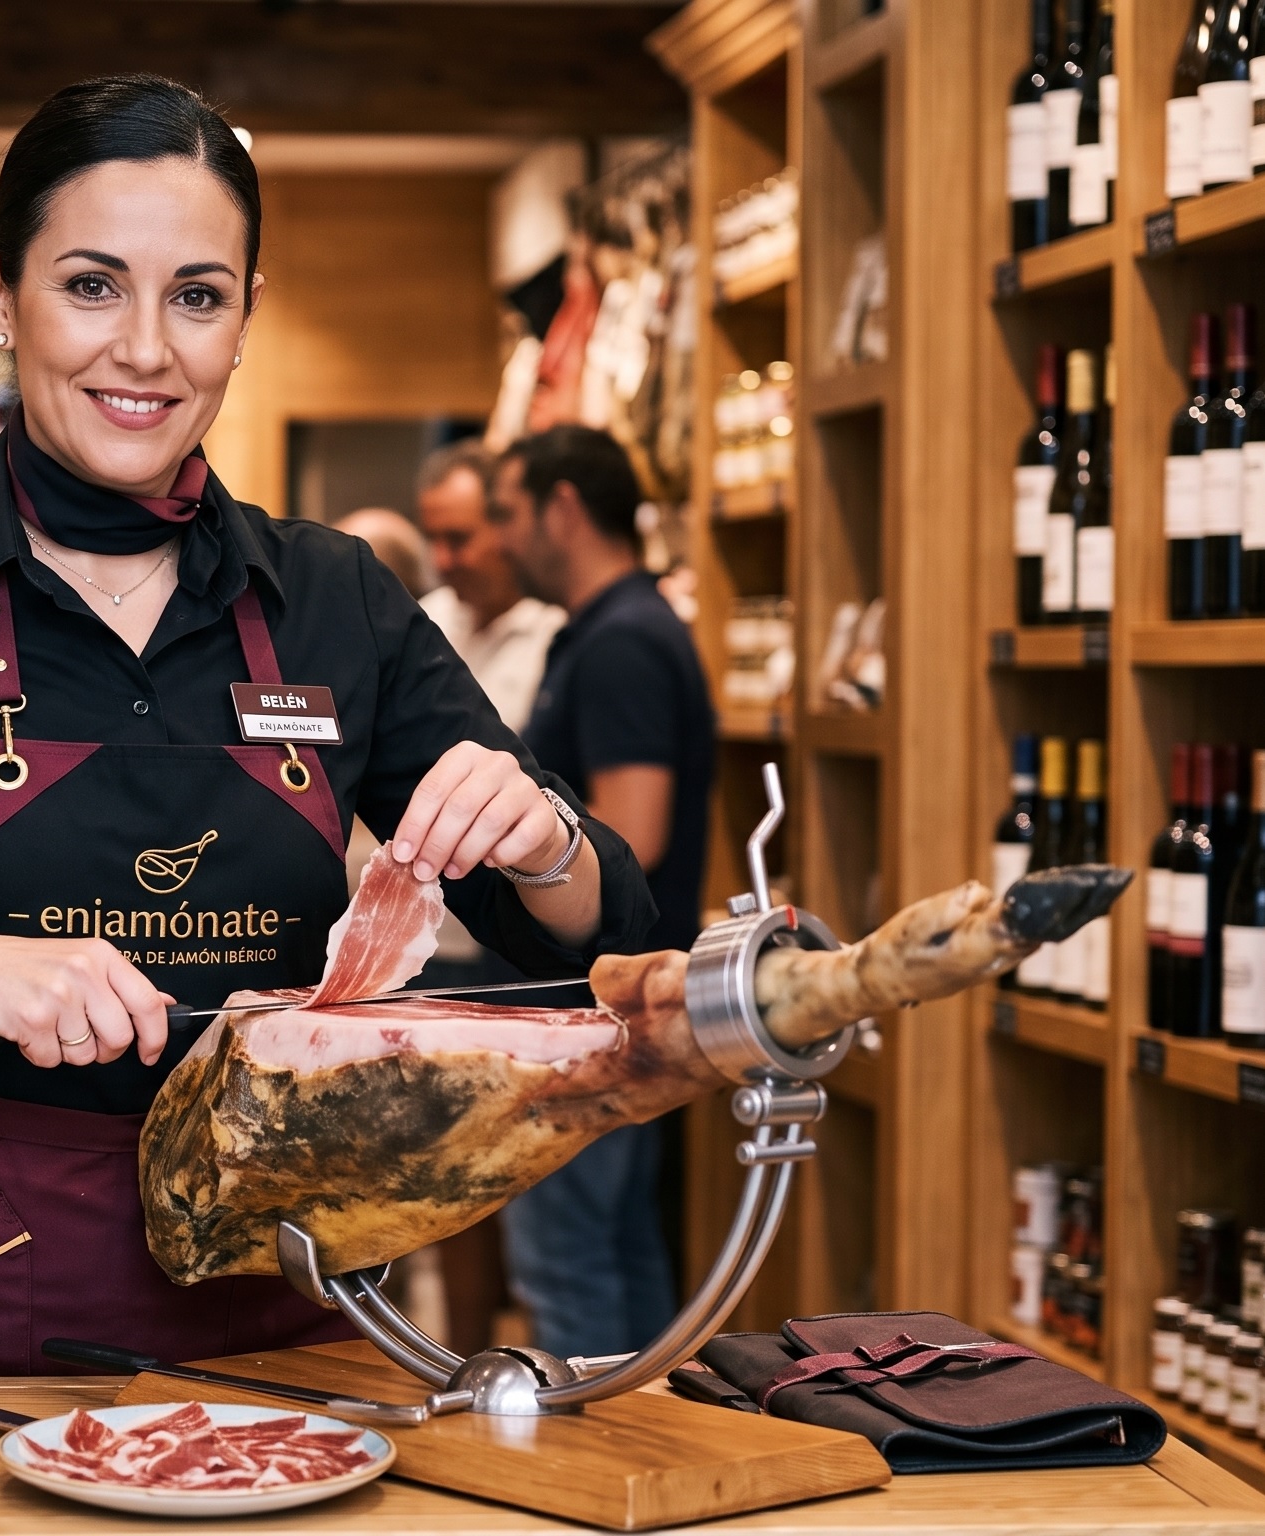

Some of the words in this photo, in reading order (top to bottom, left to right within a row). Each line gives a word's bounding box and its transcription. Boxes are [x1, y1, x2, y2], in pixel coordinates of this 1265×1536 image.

[260, 692, 307, 708] BELÉN
[259, 722, 323, 732] ENJAMÓNATE
[39, 897, 280, 939] enjamónate
[146, 951, 166, 964] DE
[169, 947, 220, 964] JAMÓN
[225, 946, 277, 963] IBÉRICO
